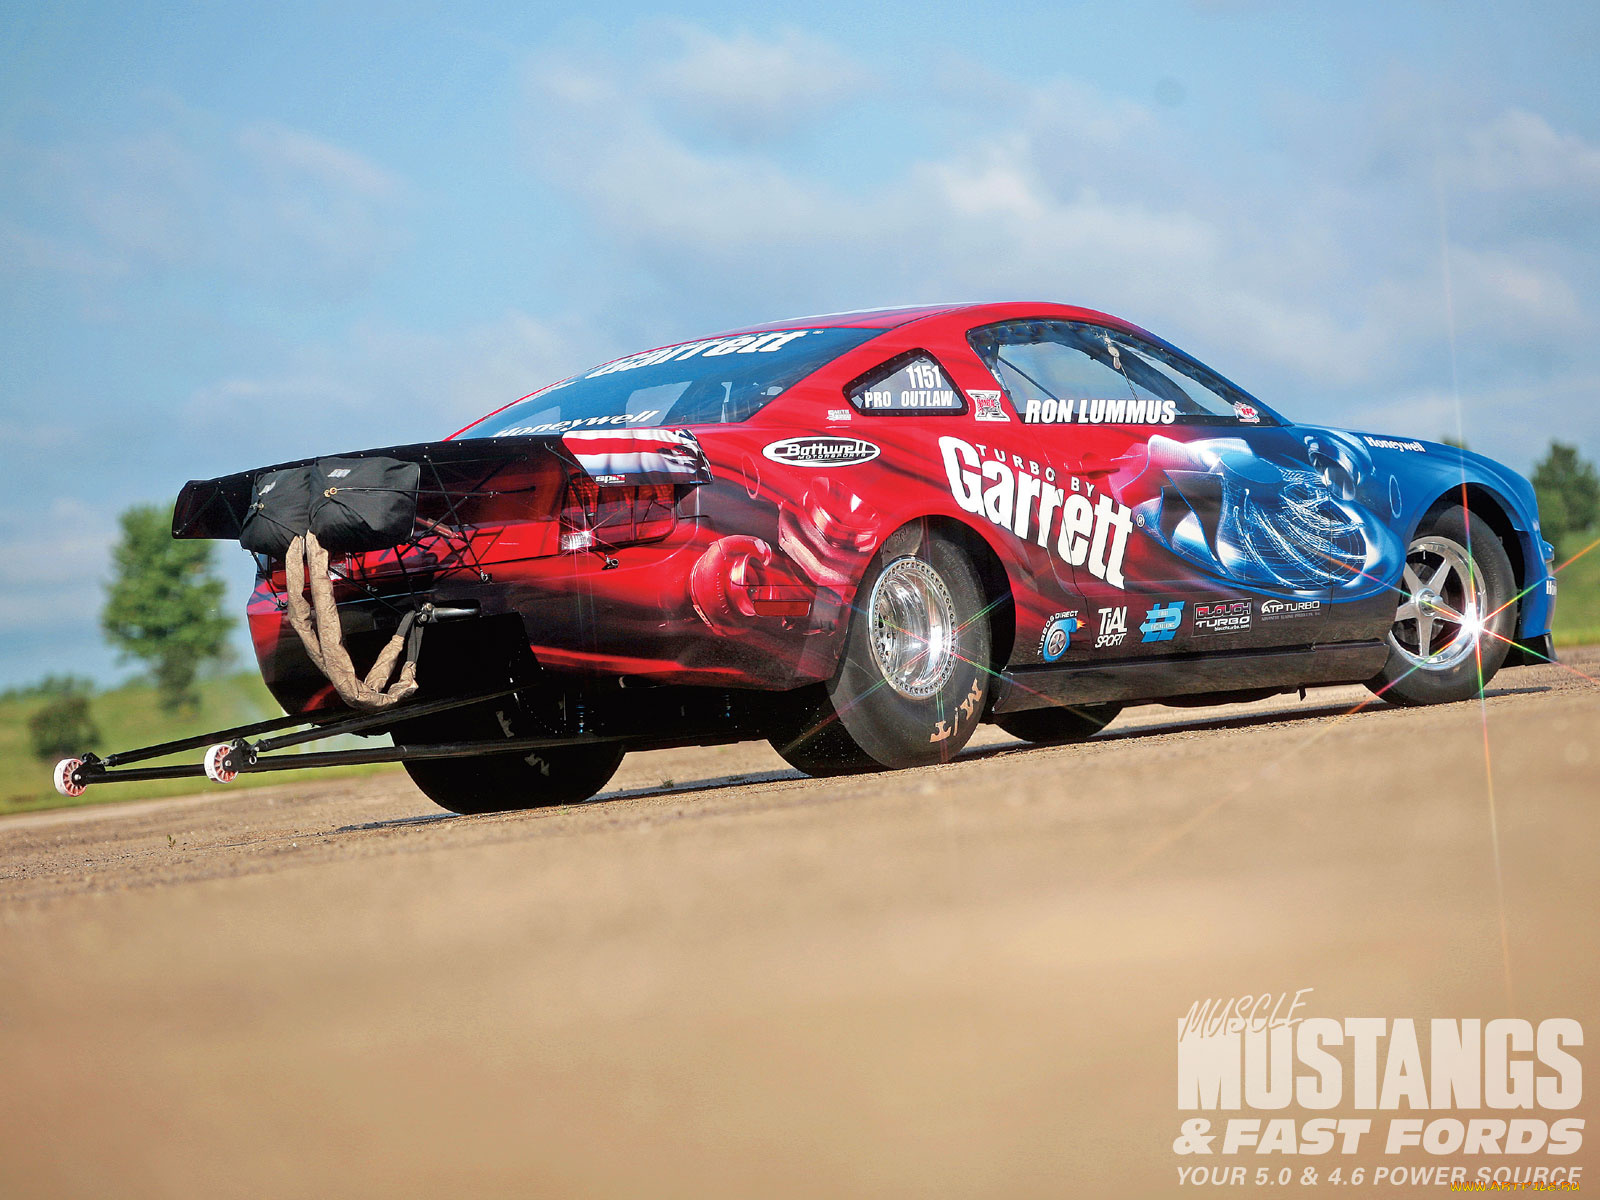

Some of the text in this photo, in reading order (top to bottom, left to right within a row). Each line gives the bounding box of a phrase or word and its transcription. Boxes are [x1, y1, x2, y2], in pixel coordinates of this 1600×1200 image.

[906, 365, 942, 388] 1151
[864, 390, 953, 408] PRO OUTLAW
[1025, 400, 1074, 423] RON
[1078, 400, 1176, 424] LUMMUS
[490, 410, 660, 438] Honeywell
[1363, 436, 1426, 452] Honeywell
[975, 443, 1095, 497] TURBO BY
[938, 436, 1134, 590] Garrett
[1261, 600, 1320, 614] ATP TURBO
[1036, 610, 1079, 655] TURBOS DIRECT
[1195, 616, 1250, 628] TURBO
[1095, 633, 1127, 648] SPORT
